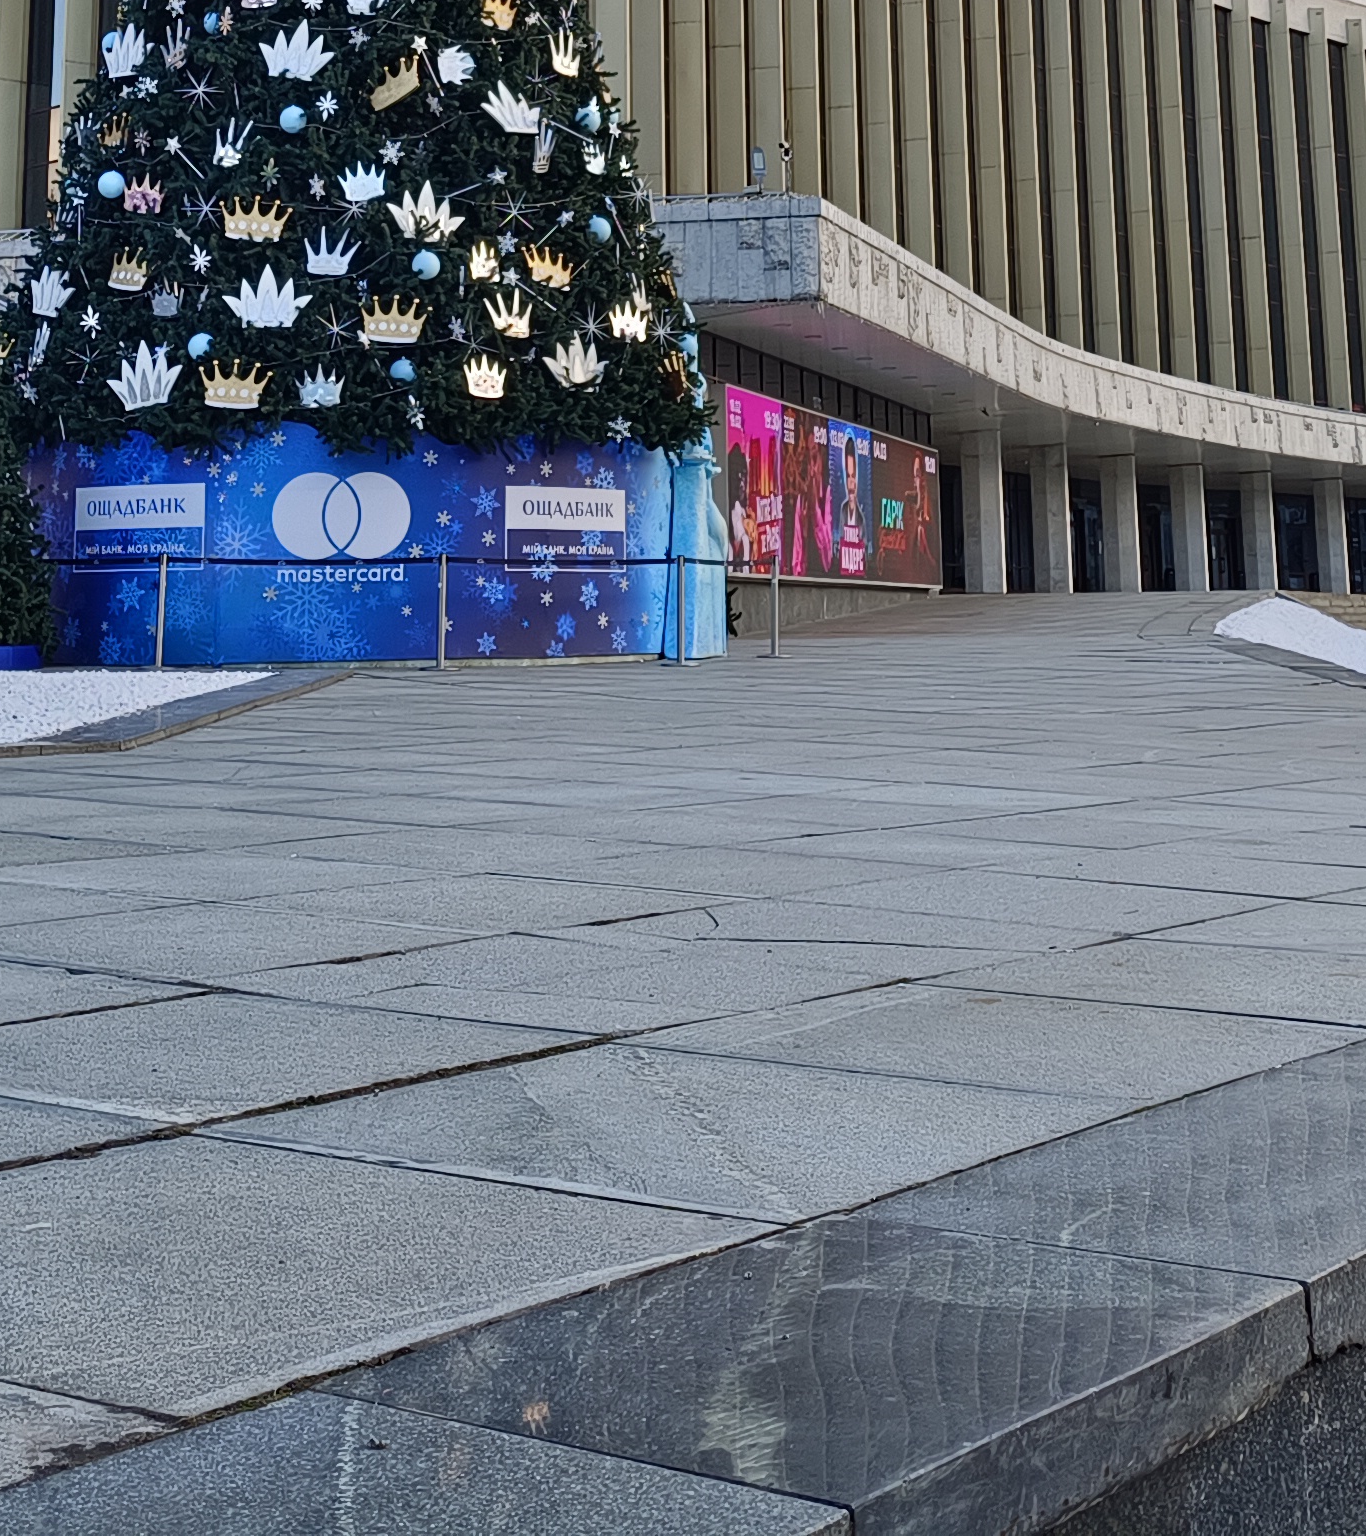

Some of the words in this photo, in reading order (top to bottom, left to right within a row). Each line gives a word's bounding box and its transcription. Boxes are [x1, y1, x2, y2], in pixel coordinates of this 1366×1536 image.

[87, 497, 186, 519] ОЩАДБАНК
[522, 499, 614, 520] ОЩАДБАНК
[127, 543, 149, 554] МОЯ
[522, 542, 542, 554] МІЙ
[568, 545, 587, 555] МОЯ
